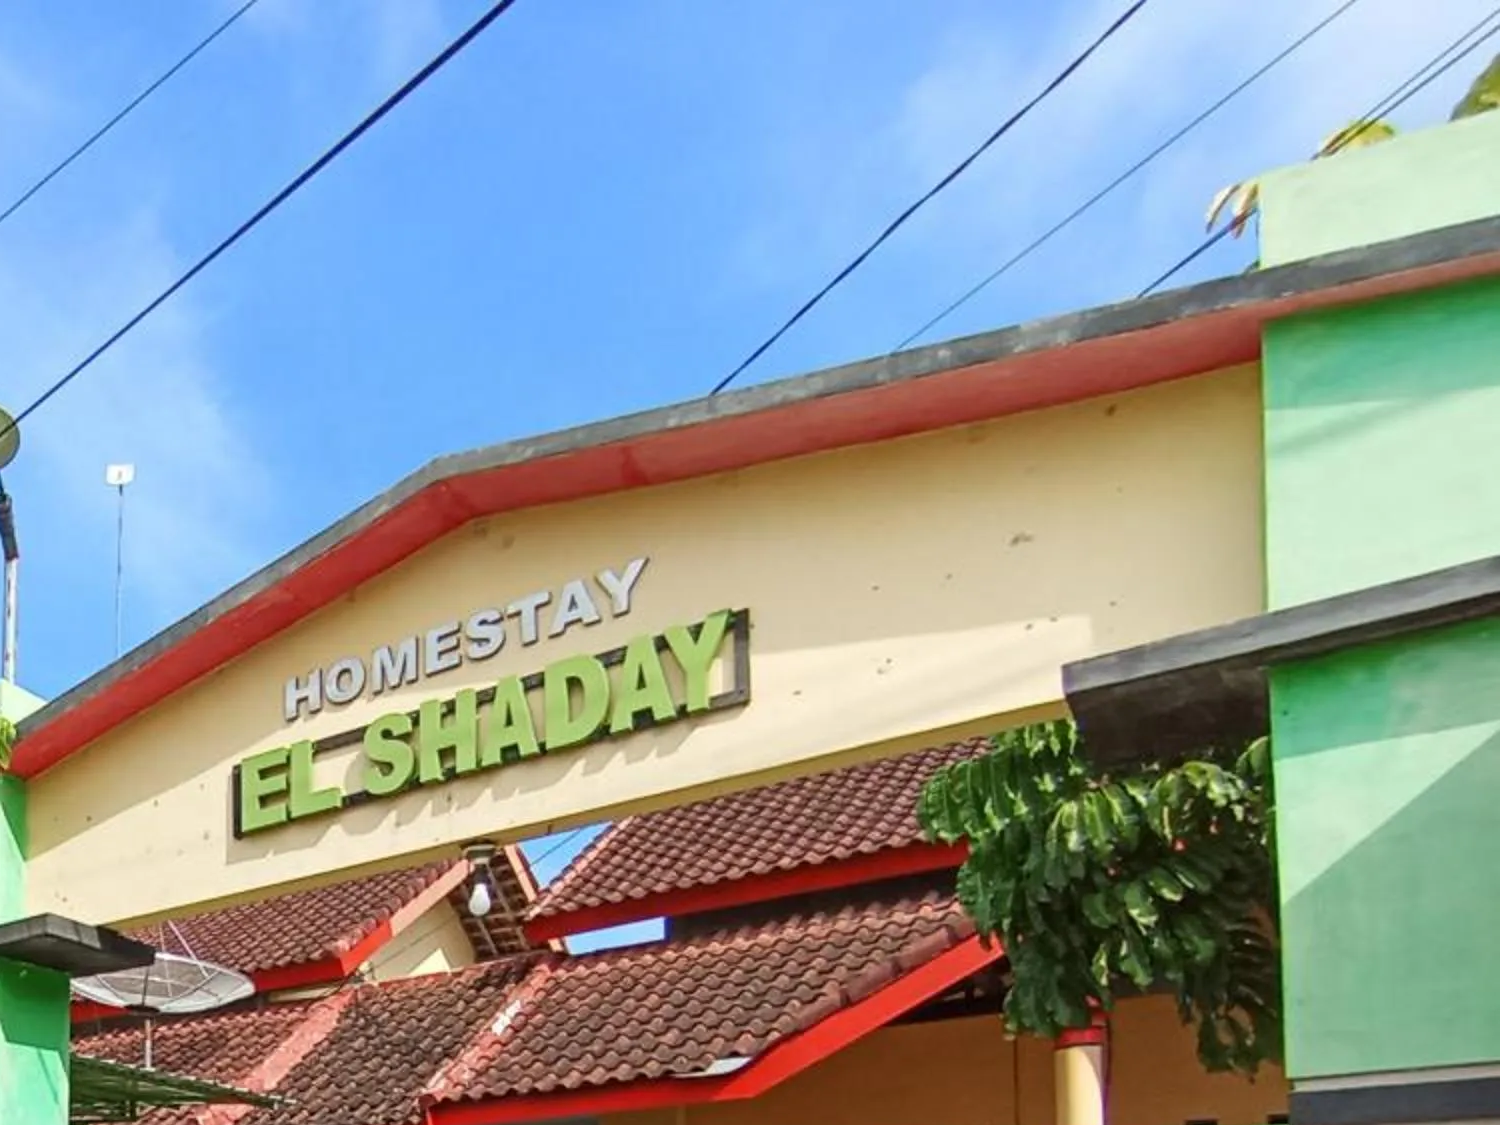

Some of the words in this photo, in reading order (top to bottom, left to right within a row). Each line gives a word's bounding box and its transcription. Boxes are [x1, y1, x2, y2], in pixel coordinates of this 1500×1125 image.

[240, 740, 342, 833] EL
[363, 610, 732, 795] SHADAY
[285, 557, 649, 721] HOMESTAY
